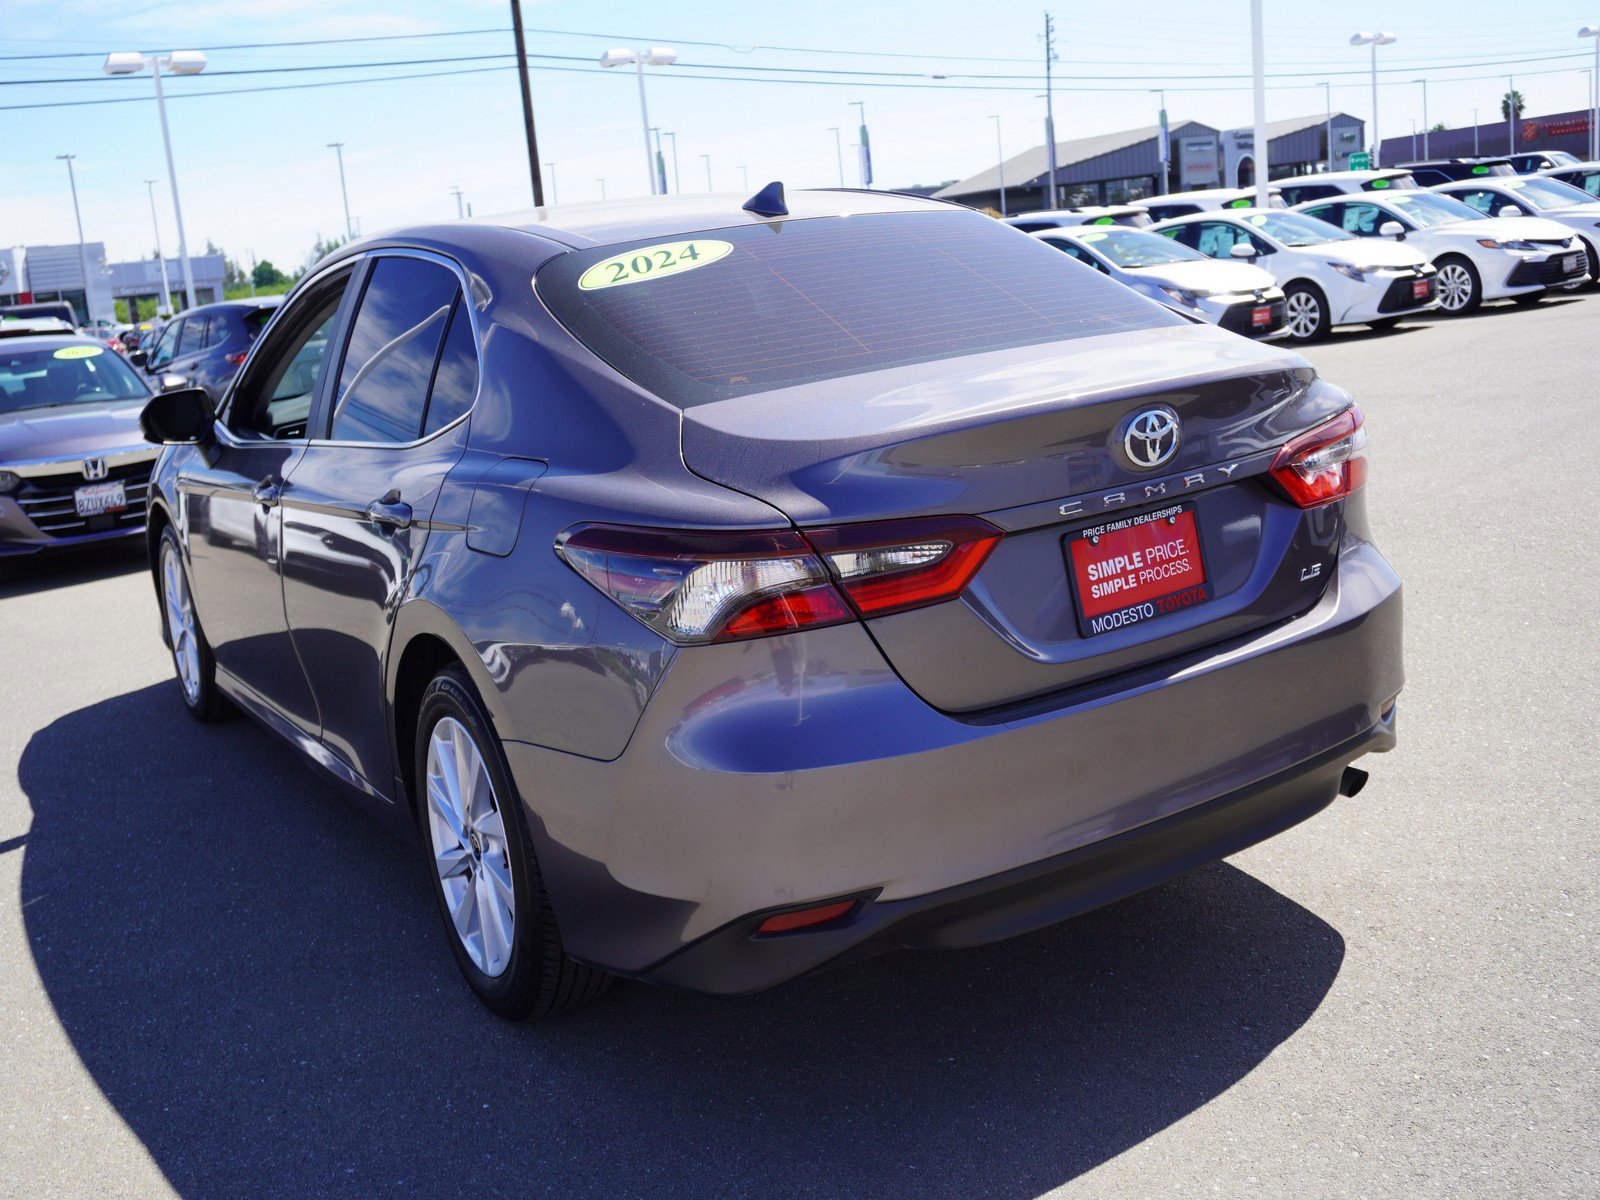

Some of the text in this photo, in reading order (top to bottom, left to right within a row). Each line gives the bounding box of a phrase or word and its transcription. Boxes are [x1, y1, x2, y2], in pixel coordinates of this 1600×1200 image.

[606, 244, 700, 283] 2024
[77, 493, 123, 512] 8ZUX649
[1059, 464, 1239, 516] CAMRY
[1083, 505, 1183, 538] PRICE FAMILY DEALERSHIPS
[1088, 539, 1190, 581] SIMPLE PRICE.
[1091, 558, 1193, 599] SIMPLE PROCESS.
[1300, 563, 1322, 581] LE
[1091, 587, 1207, 634] MODESTO TOYOTA
